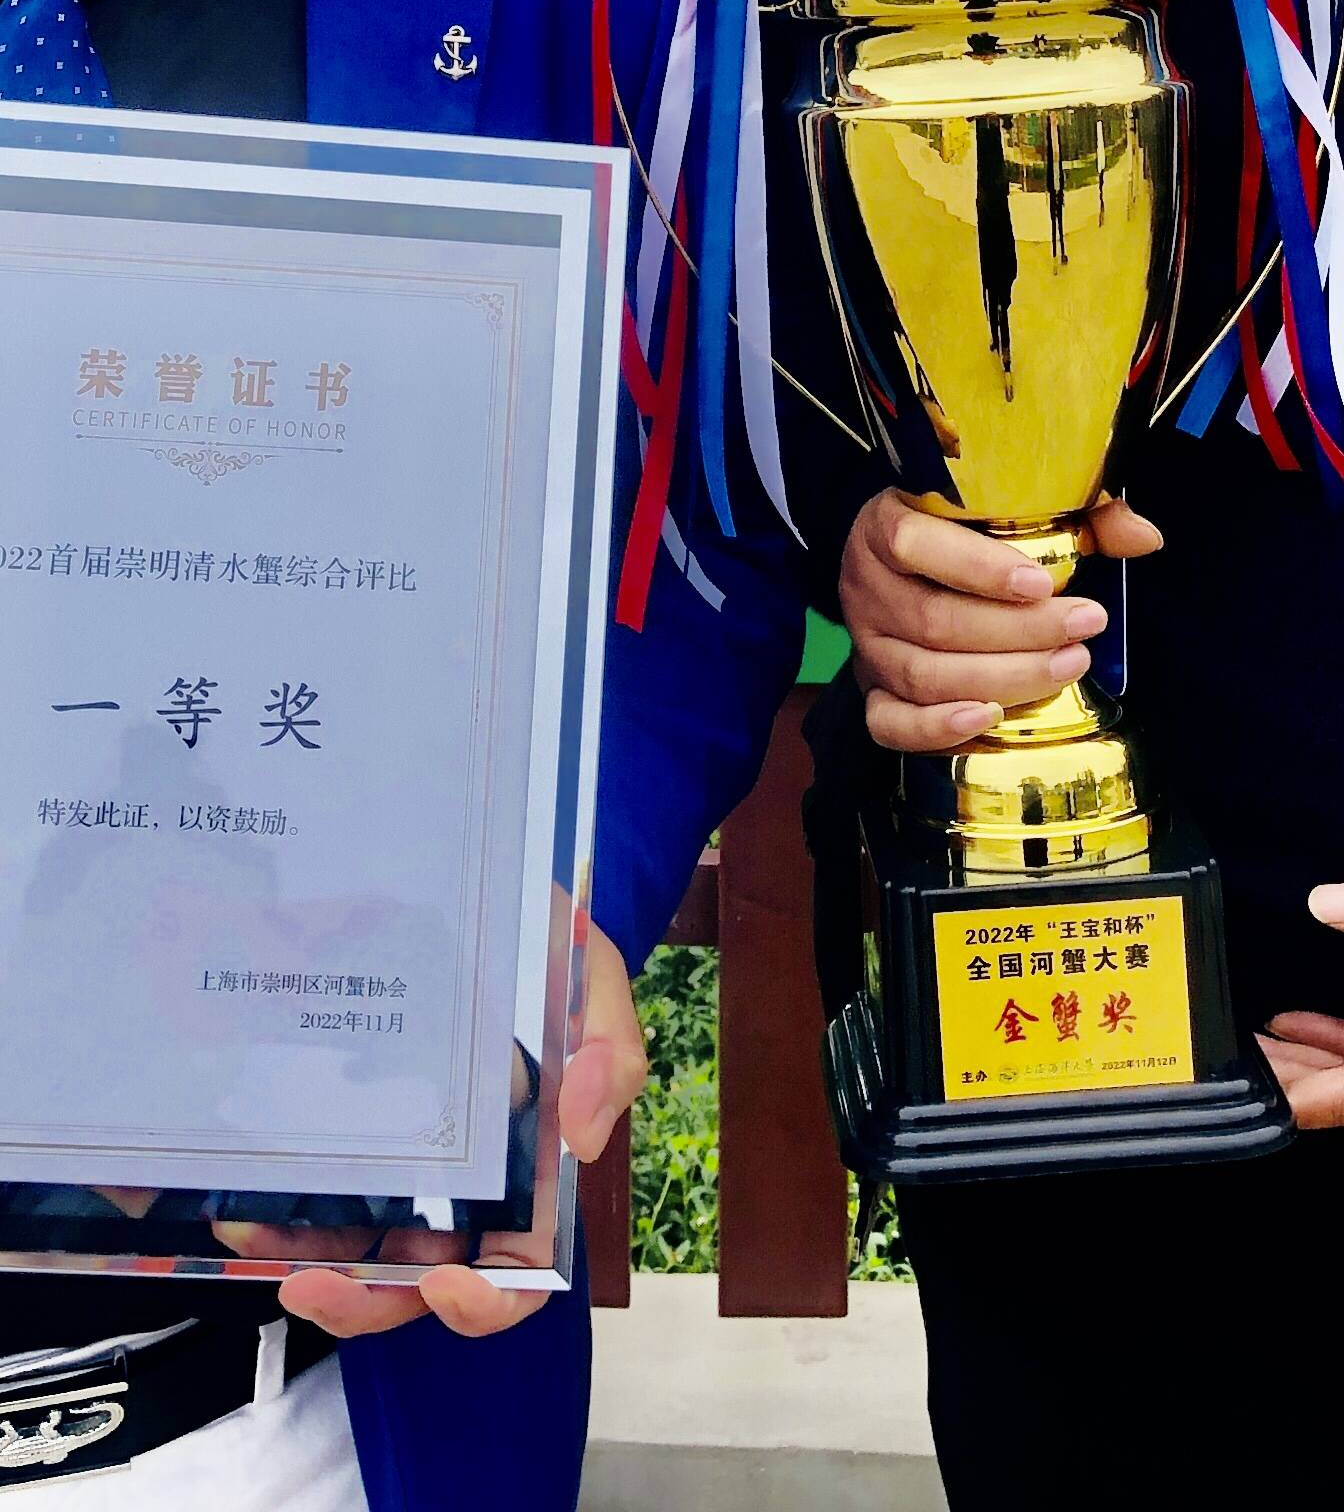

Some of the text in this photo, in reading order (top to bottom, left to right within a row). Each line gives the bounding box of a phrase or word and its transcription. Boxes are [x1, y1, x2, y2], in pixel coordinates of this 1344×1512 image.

[76, 348, 353, 412] 荣誉证书
[71, 408, 348, 442] CERTIFICATE OF HONOR
[50, 676, 322, 750] 一等奖
[966, 943, 1151, 982] 全国河蟹大赛
[196, 970, 408, 1000] 上海市崇明区河蟹协会
[299, 1010, 404, 1034] 2022年11月
[994, 990, 1137, 1044] 金蟹奖
[961, 1070, 988, 1084] 主办
